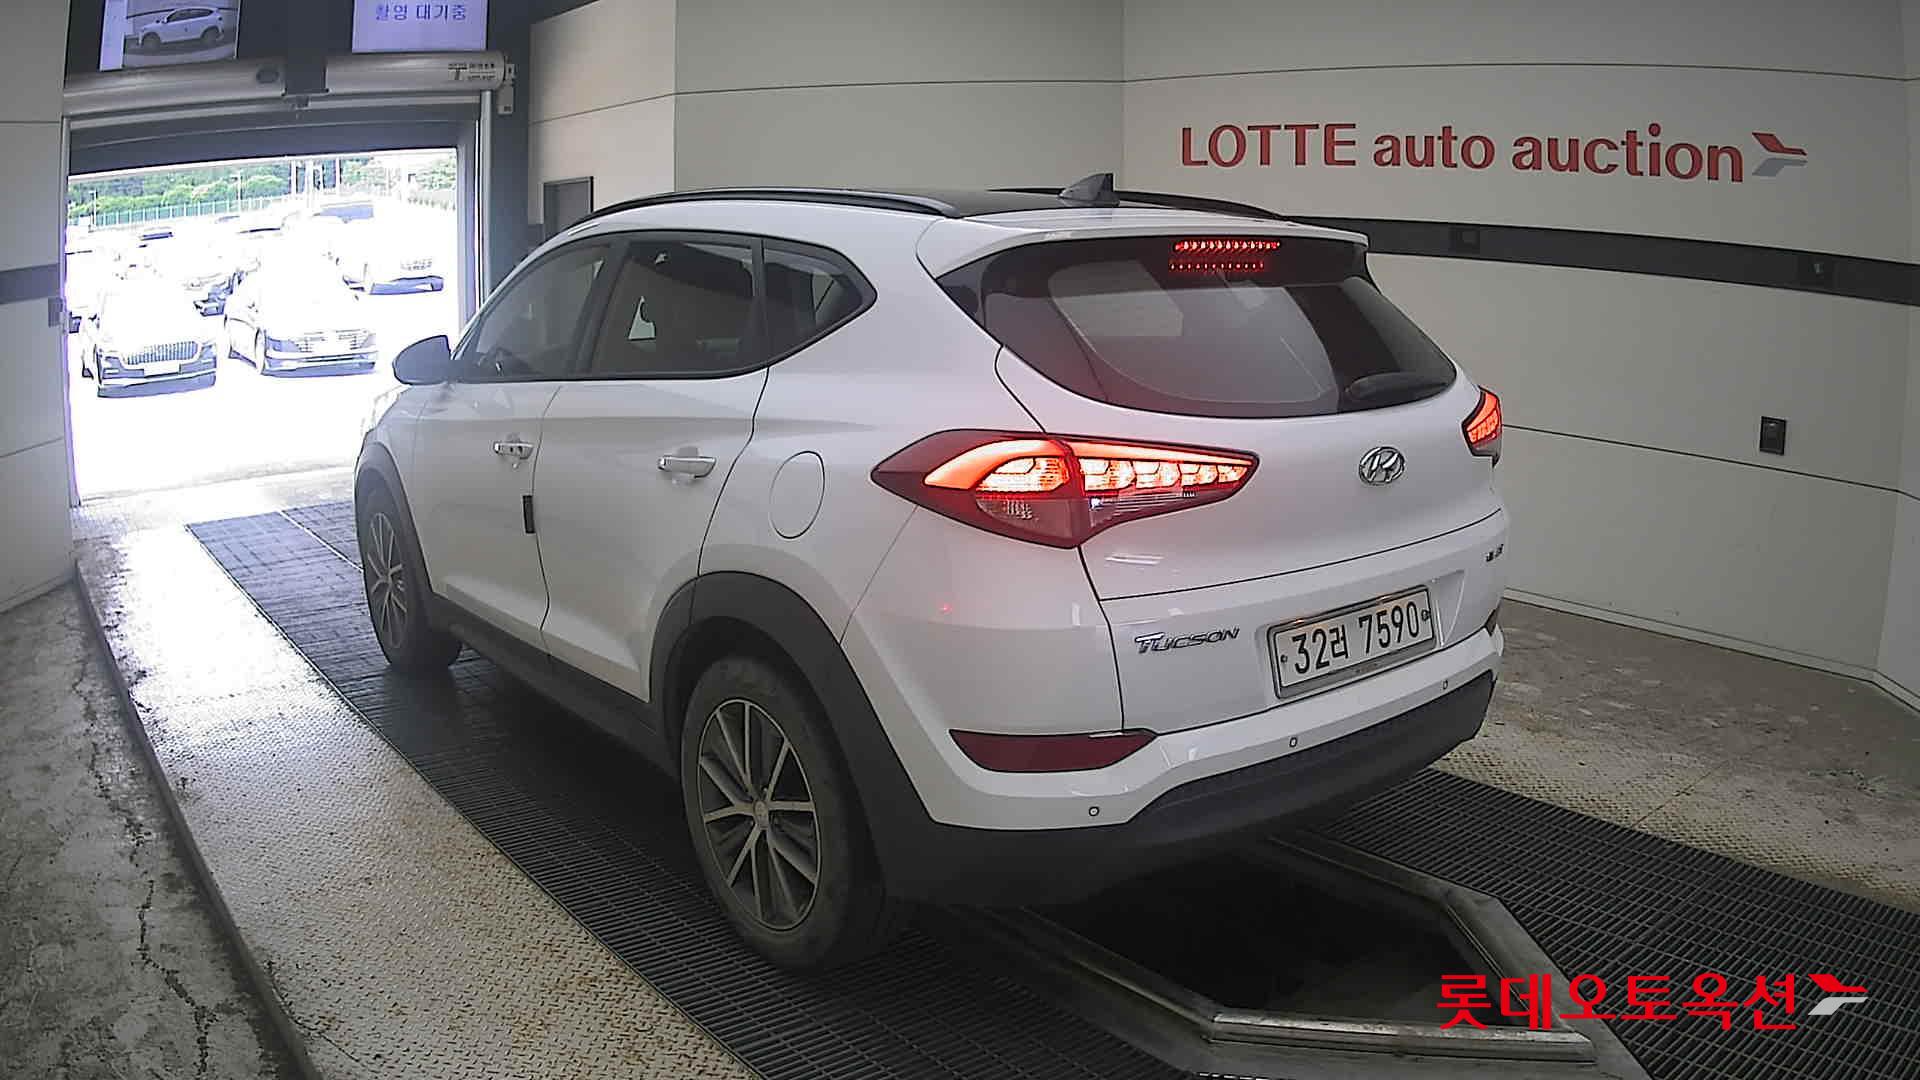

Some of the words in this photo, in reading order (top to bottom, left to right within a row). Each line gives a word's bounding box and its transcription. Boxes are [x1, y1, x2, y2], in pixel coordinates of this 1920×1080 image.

[416, 4, 466, 21] 대기중
[1182, 123, 1357, 167] LOTTE
[1373, 125, 1496, 169] auto
[1511, 123, 1744, 183] auction
[1135, 627, 1240, 654] TUCSON
[1291, 624, 1349, 674] 32러
[1358, 601, 1420, 655] 7590
